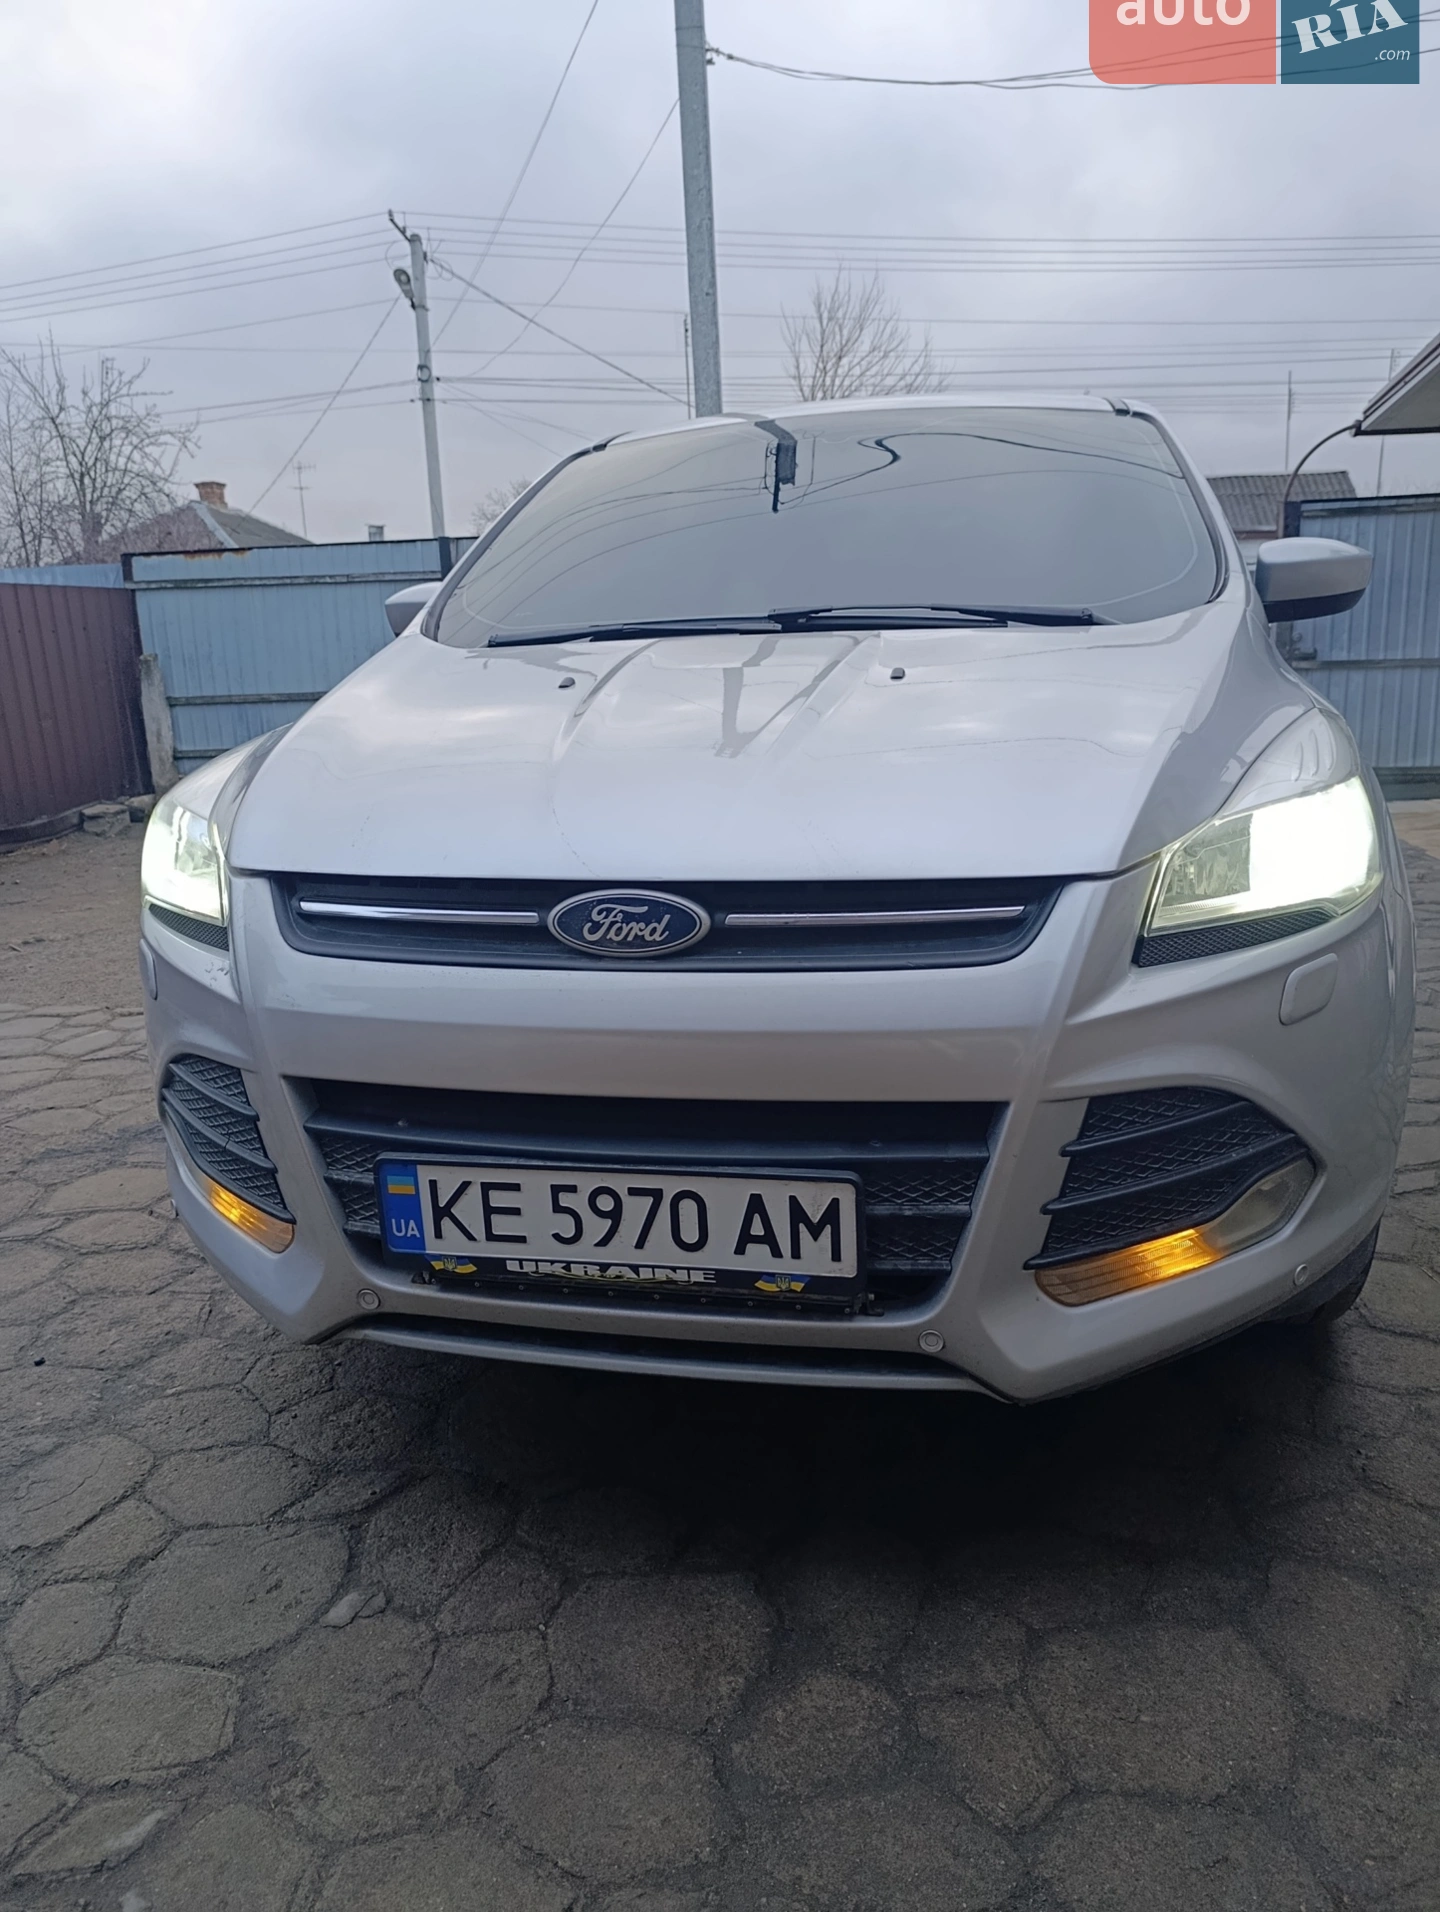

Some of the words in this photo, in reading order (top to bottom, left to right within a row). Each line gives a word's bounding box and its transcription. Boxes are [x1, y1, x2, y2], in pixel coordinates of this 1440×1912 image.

[582, 903, 672, 942] Ford
[391, 1218, 421, 1238] UA
[428, 1179, 528, 1244] KE
[549, 1183, 710, 1253] 5970
[733, 1192, 842, 1263] AM
[505, 1260, 717, 1284] UKRAINE
